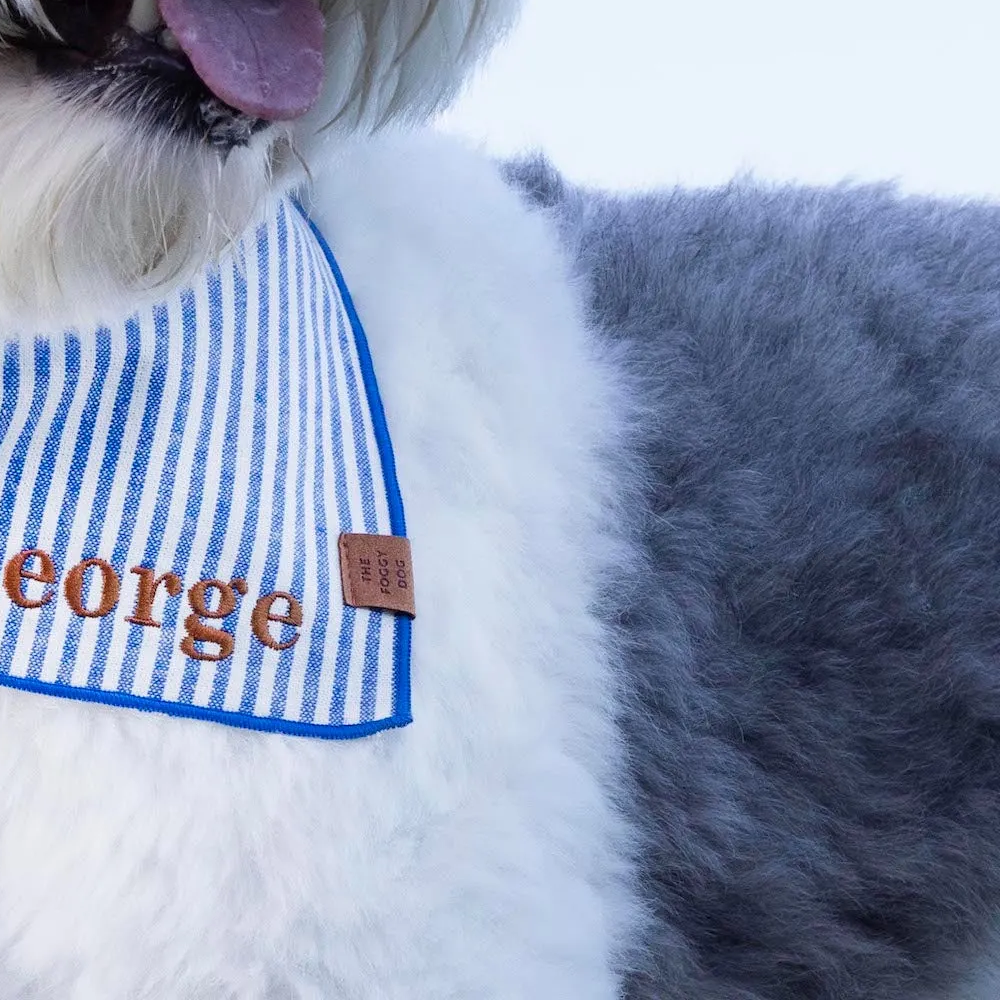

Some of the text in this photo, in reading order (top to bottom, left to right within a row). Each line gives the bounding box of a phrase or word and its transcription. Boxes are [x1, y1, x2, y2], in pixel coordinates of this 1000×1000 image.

[360, 558, 372, 582] THE
[377, 550, 391, 595] FOGGY
[396, 560, 408, 589] DOG
